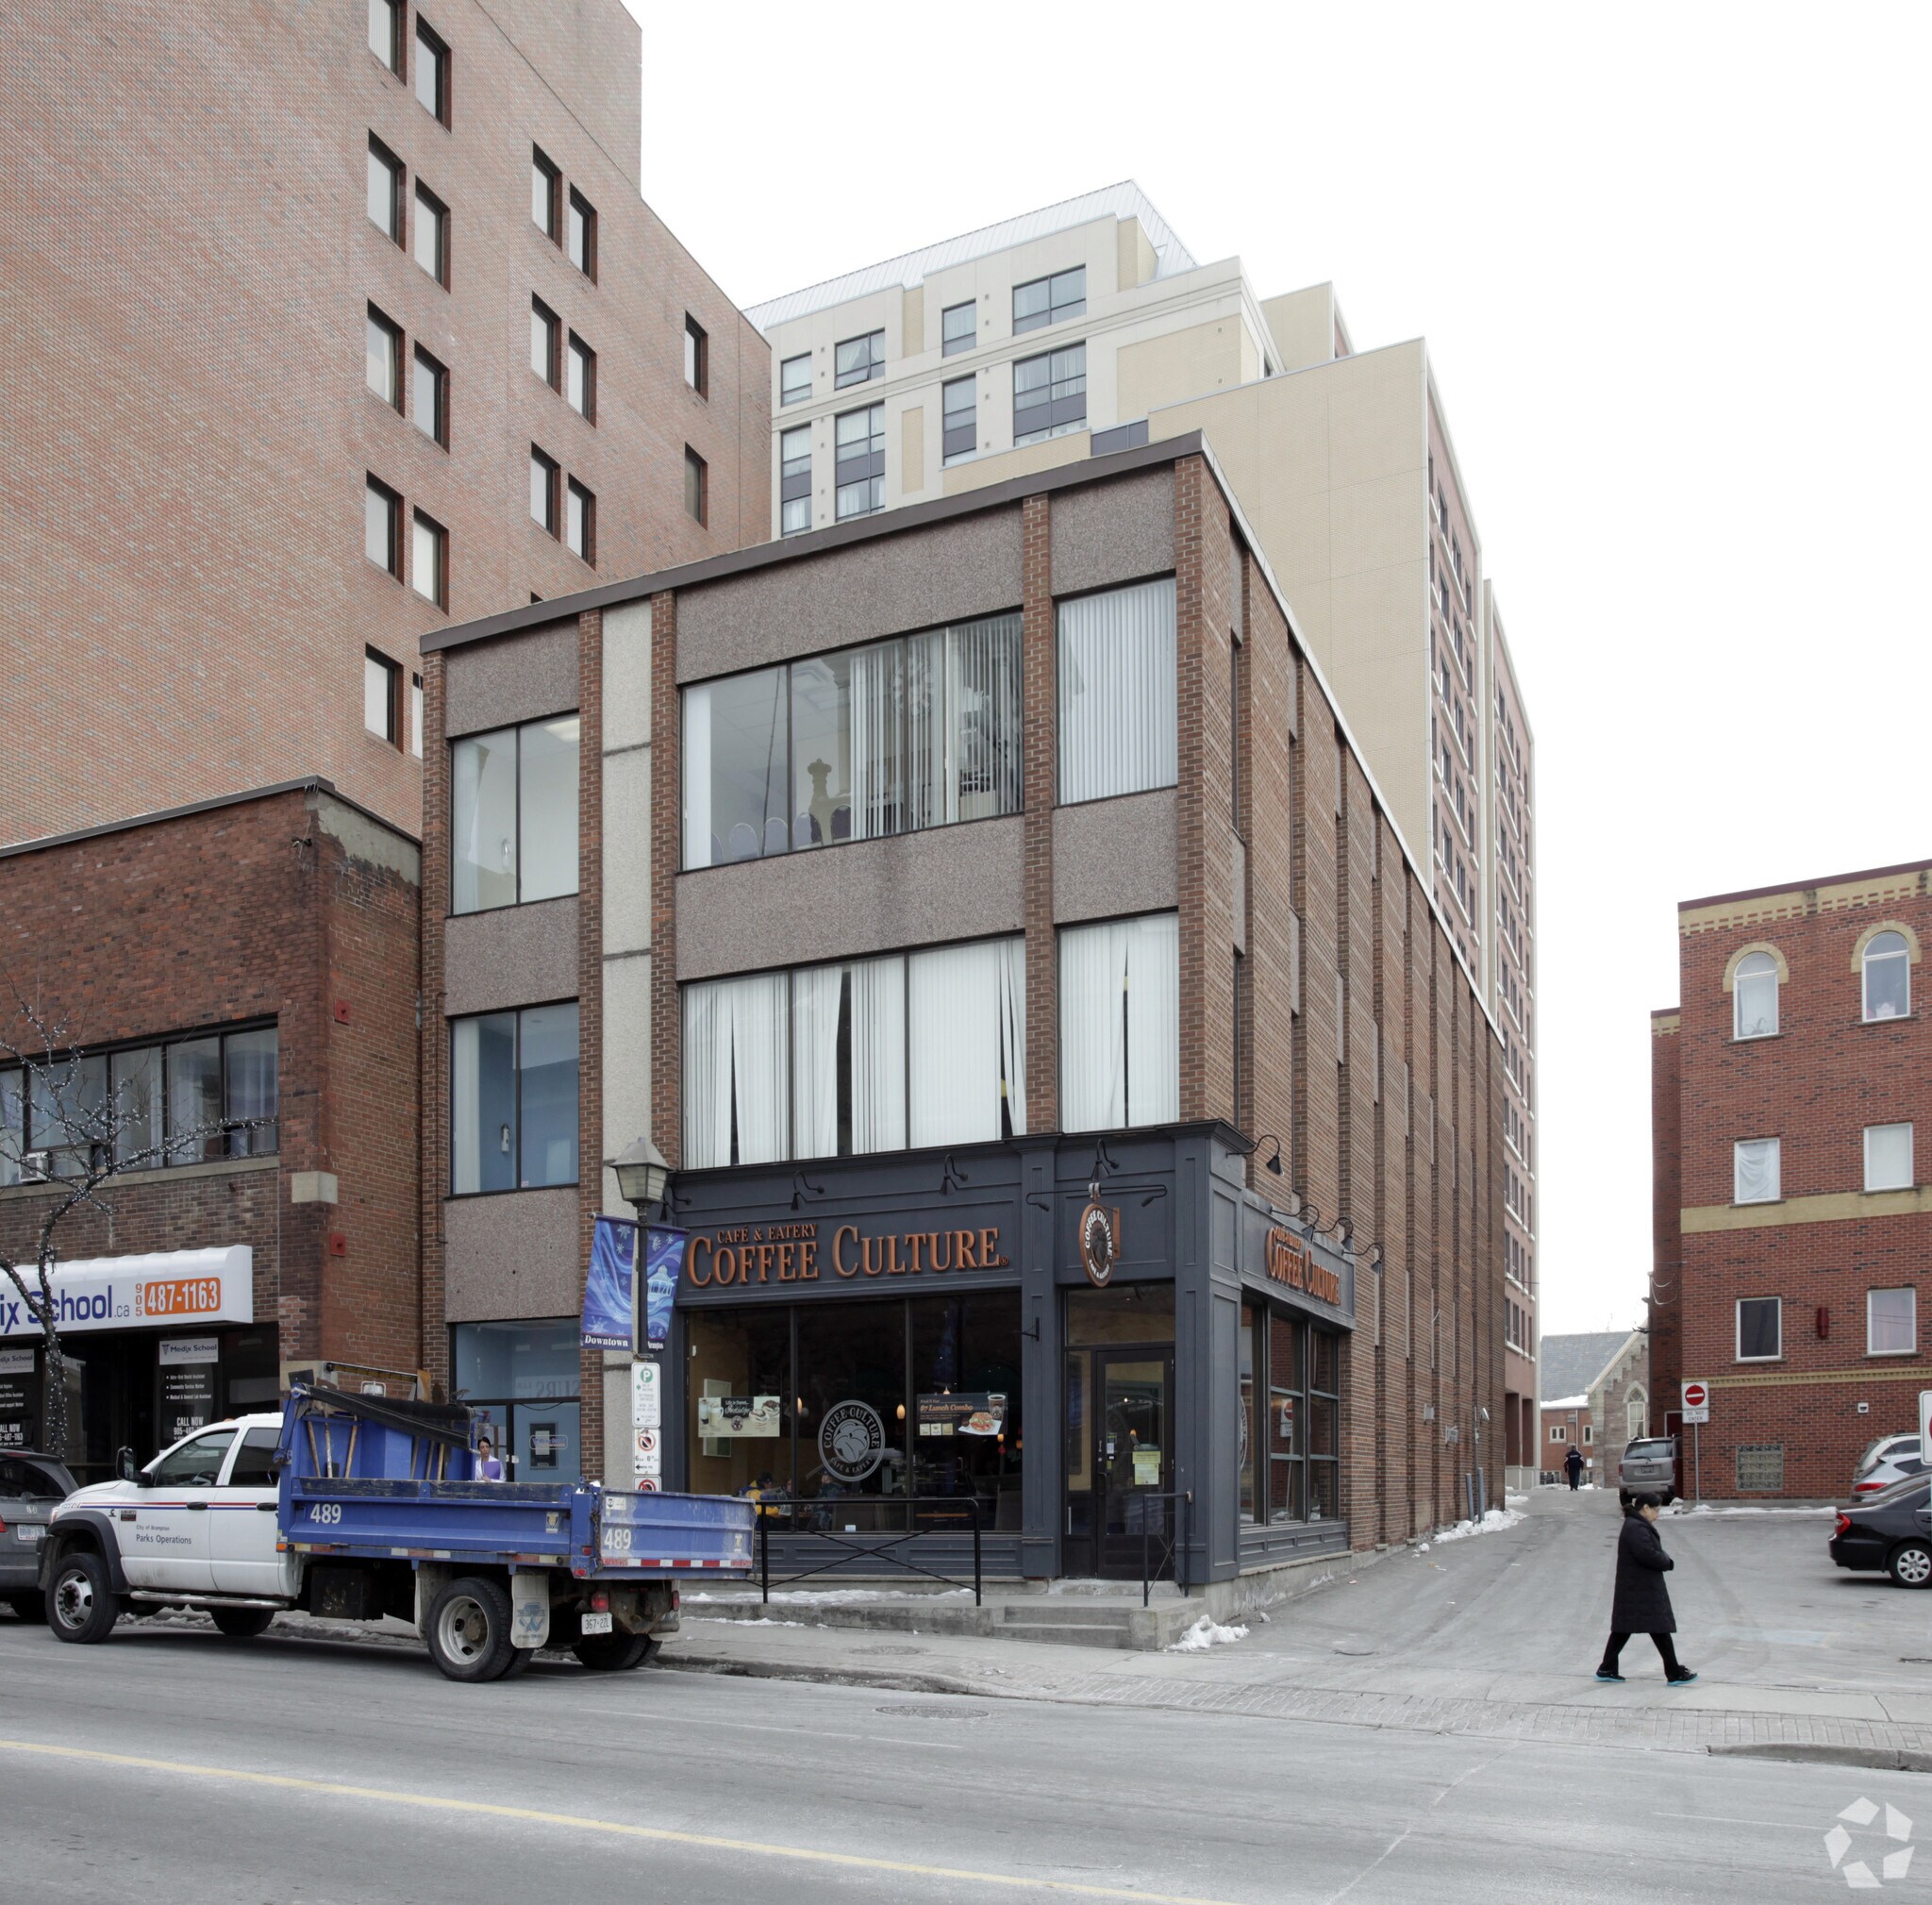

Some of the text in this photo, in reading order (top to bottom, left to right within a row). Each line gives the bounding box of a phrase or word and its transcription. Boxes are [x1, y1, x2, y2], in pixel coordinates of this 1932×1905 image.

[717, 1224, 817, 1244] CAFÉ & EATERY
[688, 1236, 819, 1287] COFFEE
[147, 1280, 218, 1312] 487-1163
[585, 1334, 628, 1347] Downtown
[950, 1403, 974, 1412] Combo
[177, 1417, 204, 1426] CALL NOW
[824, 1407, 880, 1448] COFFEE CULTURE
[309, 1504, 341, 1524] 489
[136, 1534, 192, 1545] Parks Operations
[604, 1529, 632, 1550] 489
